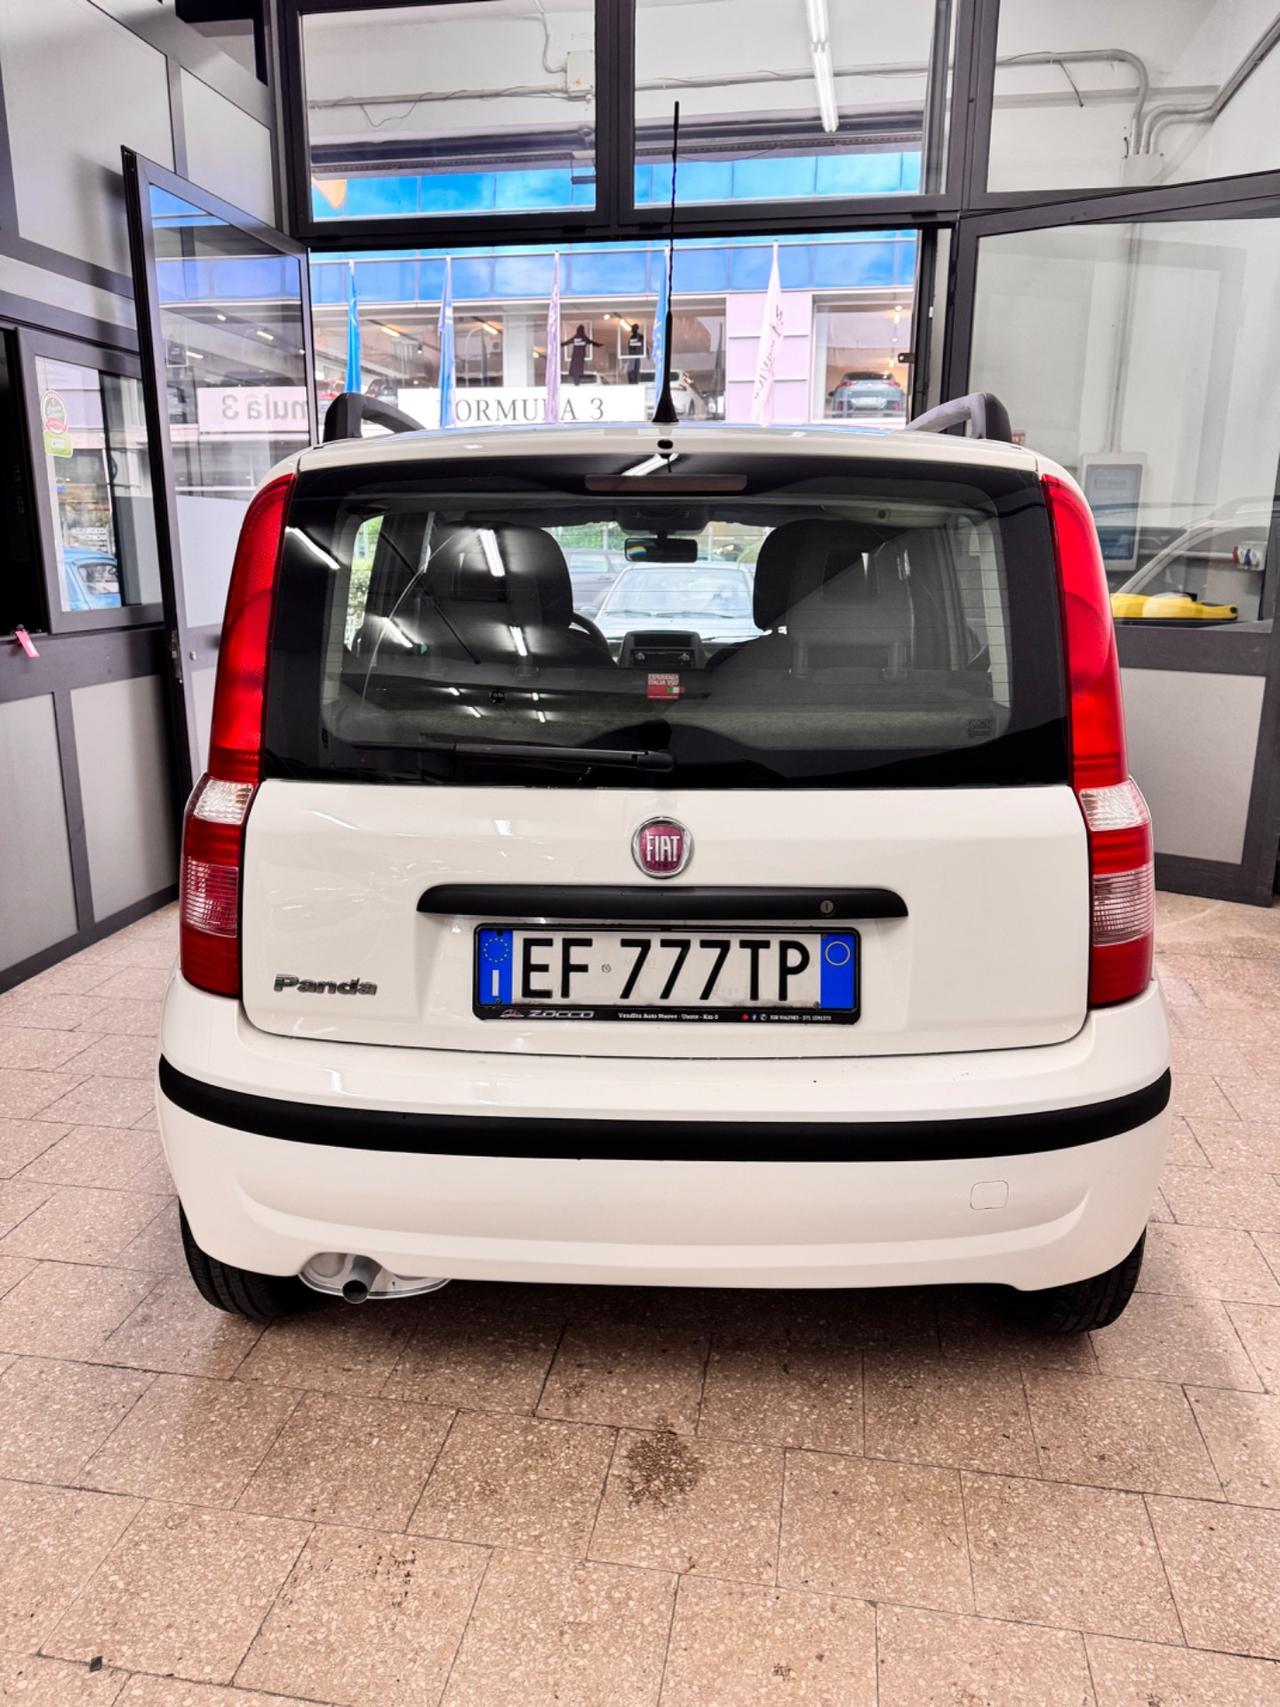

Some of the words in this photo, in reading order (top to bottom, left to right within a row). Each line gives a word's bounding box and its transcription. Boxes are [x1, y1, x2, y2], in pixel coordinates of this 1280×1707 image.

[437, 397, 578, 422] ORMUA
[590, 397, 604, 421] 3
[645, 833, 681, 862] FIAT
[492, 969, 500, 997] I
[521, 937, 593, 999] EF
[619, 938, 811, 1001] 777TP
[273, 974, 378, 996] Panda
